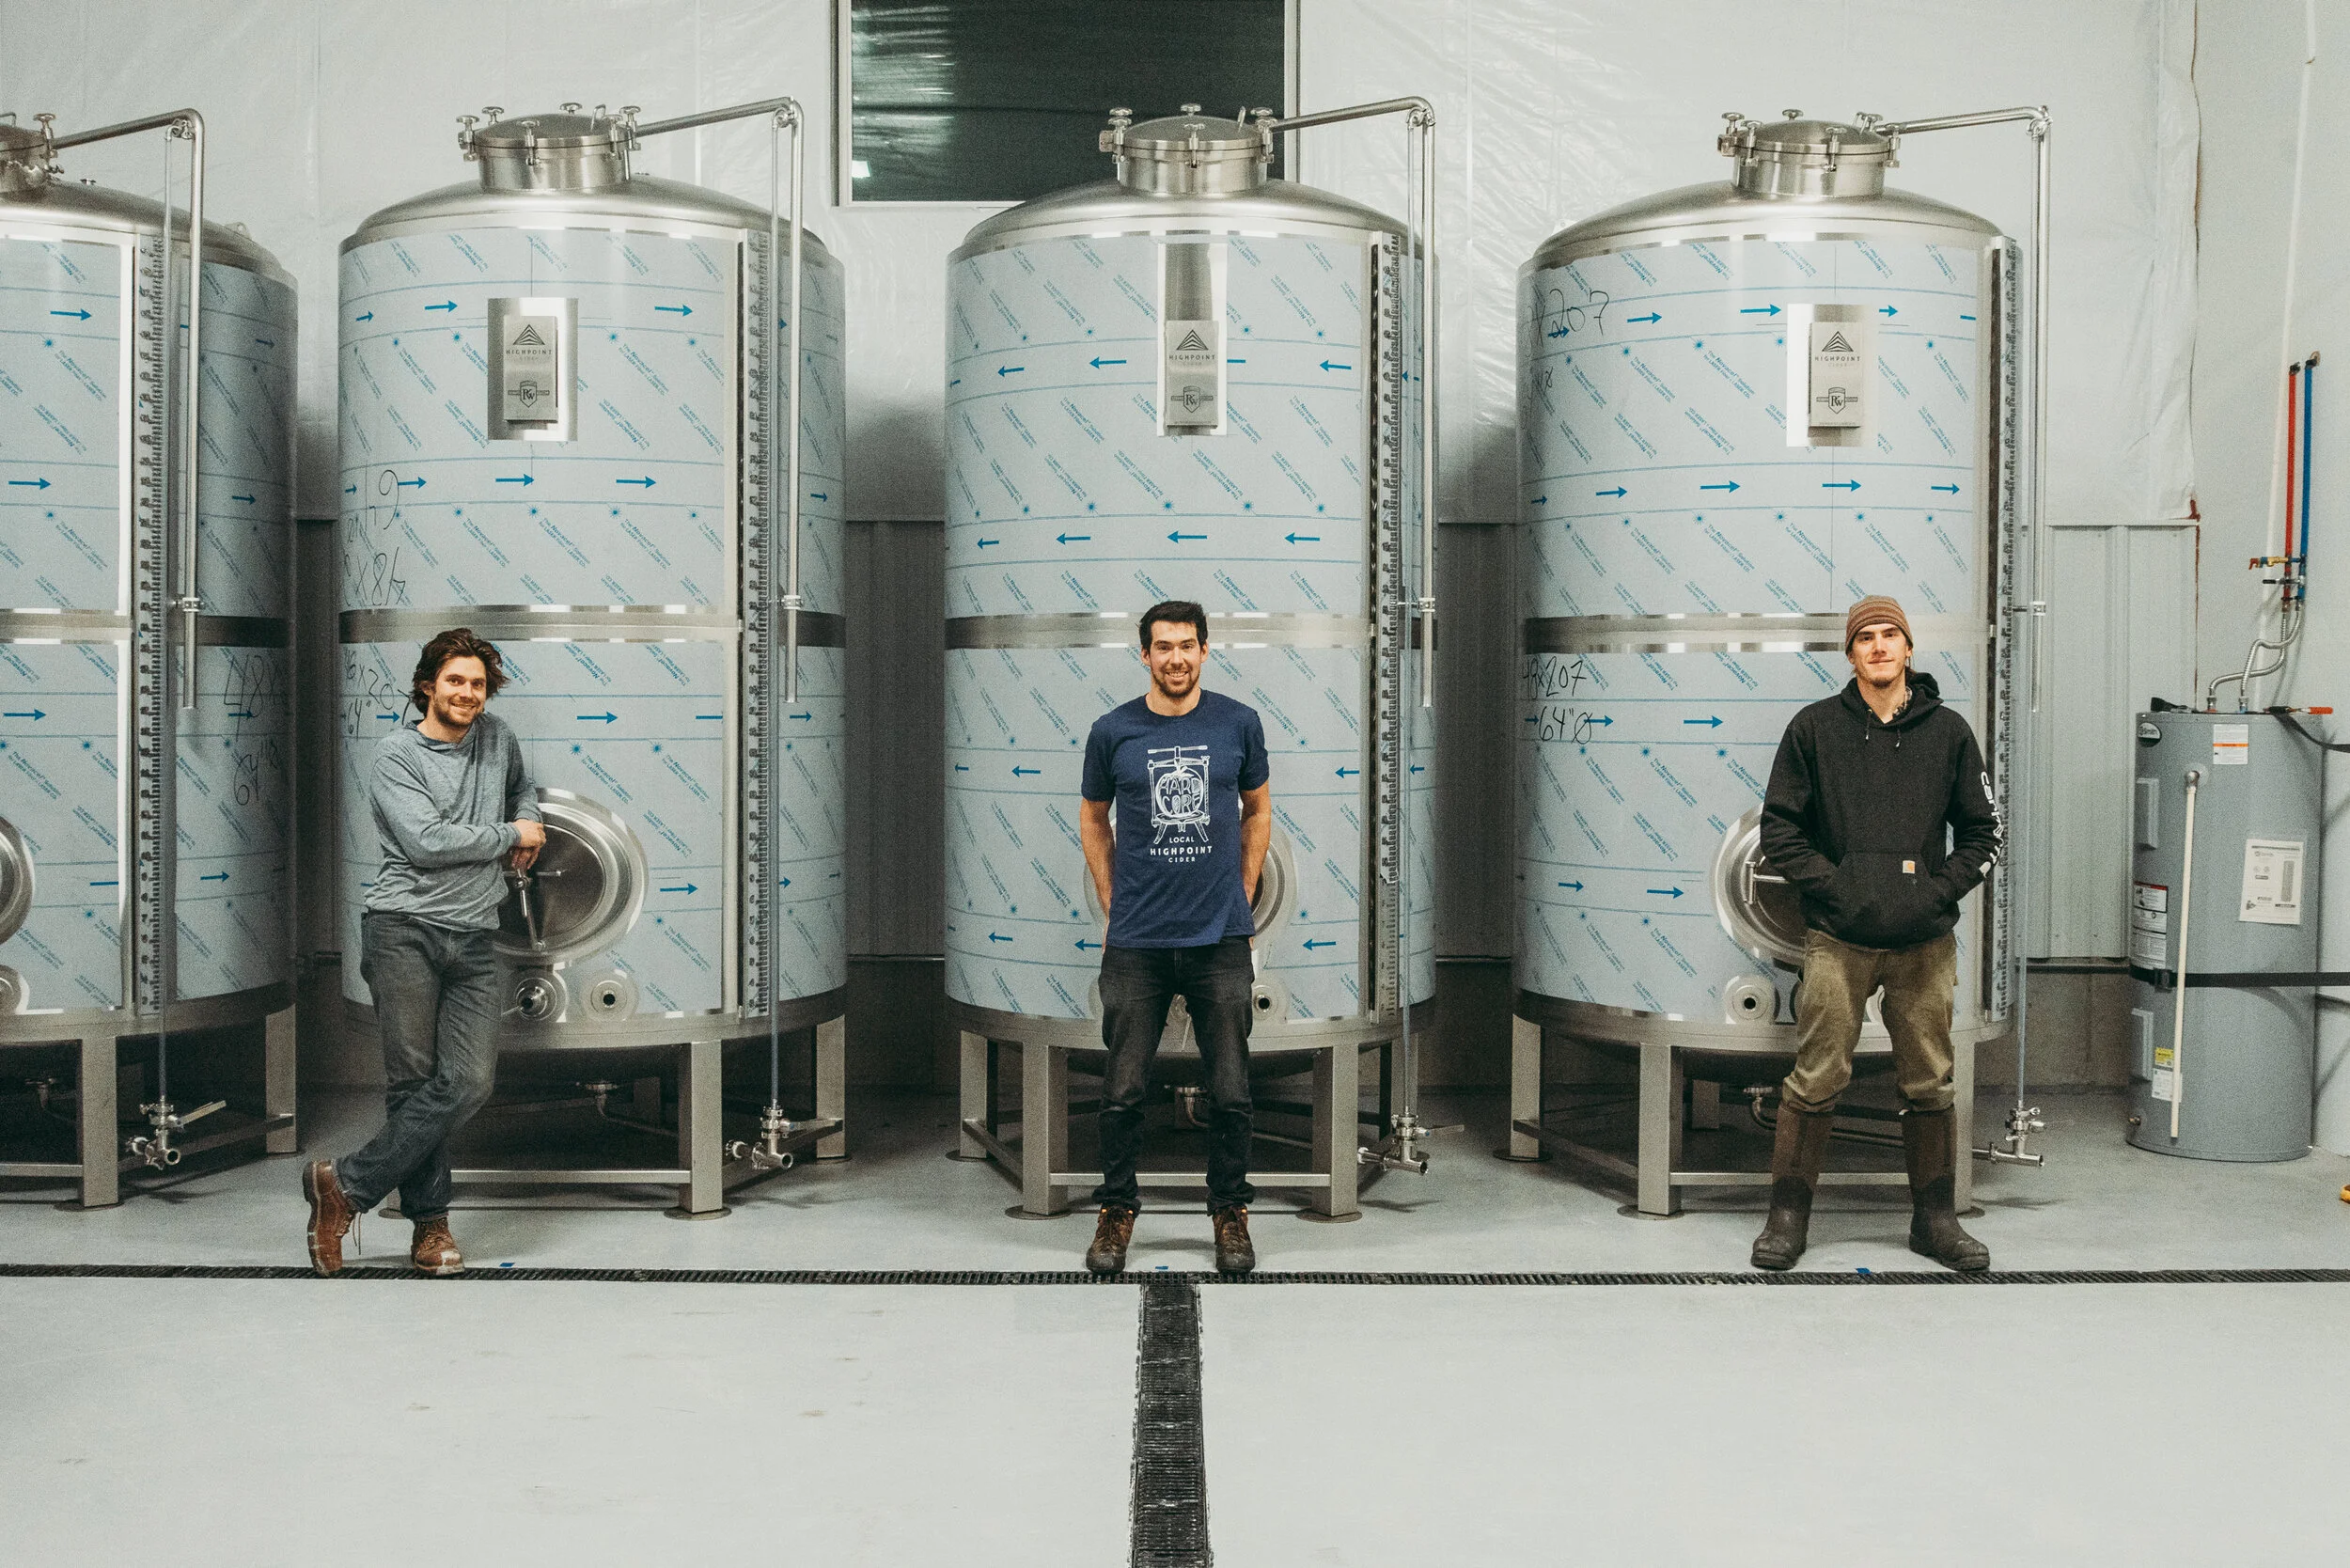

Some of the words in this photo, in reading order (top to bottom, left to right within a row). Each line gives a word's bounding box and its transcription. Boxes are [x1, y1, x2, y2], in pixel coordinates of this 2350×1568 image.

[1160, 777, 1201, 795] HARD
[1162, 793, 1199, 815] CORE
[1150, 846, 1213, 855] HIGHPOINT
